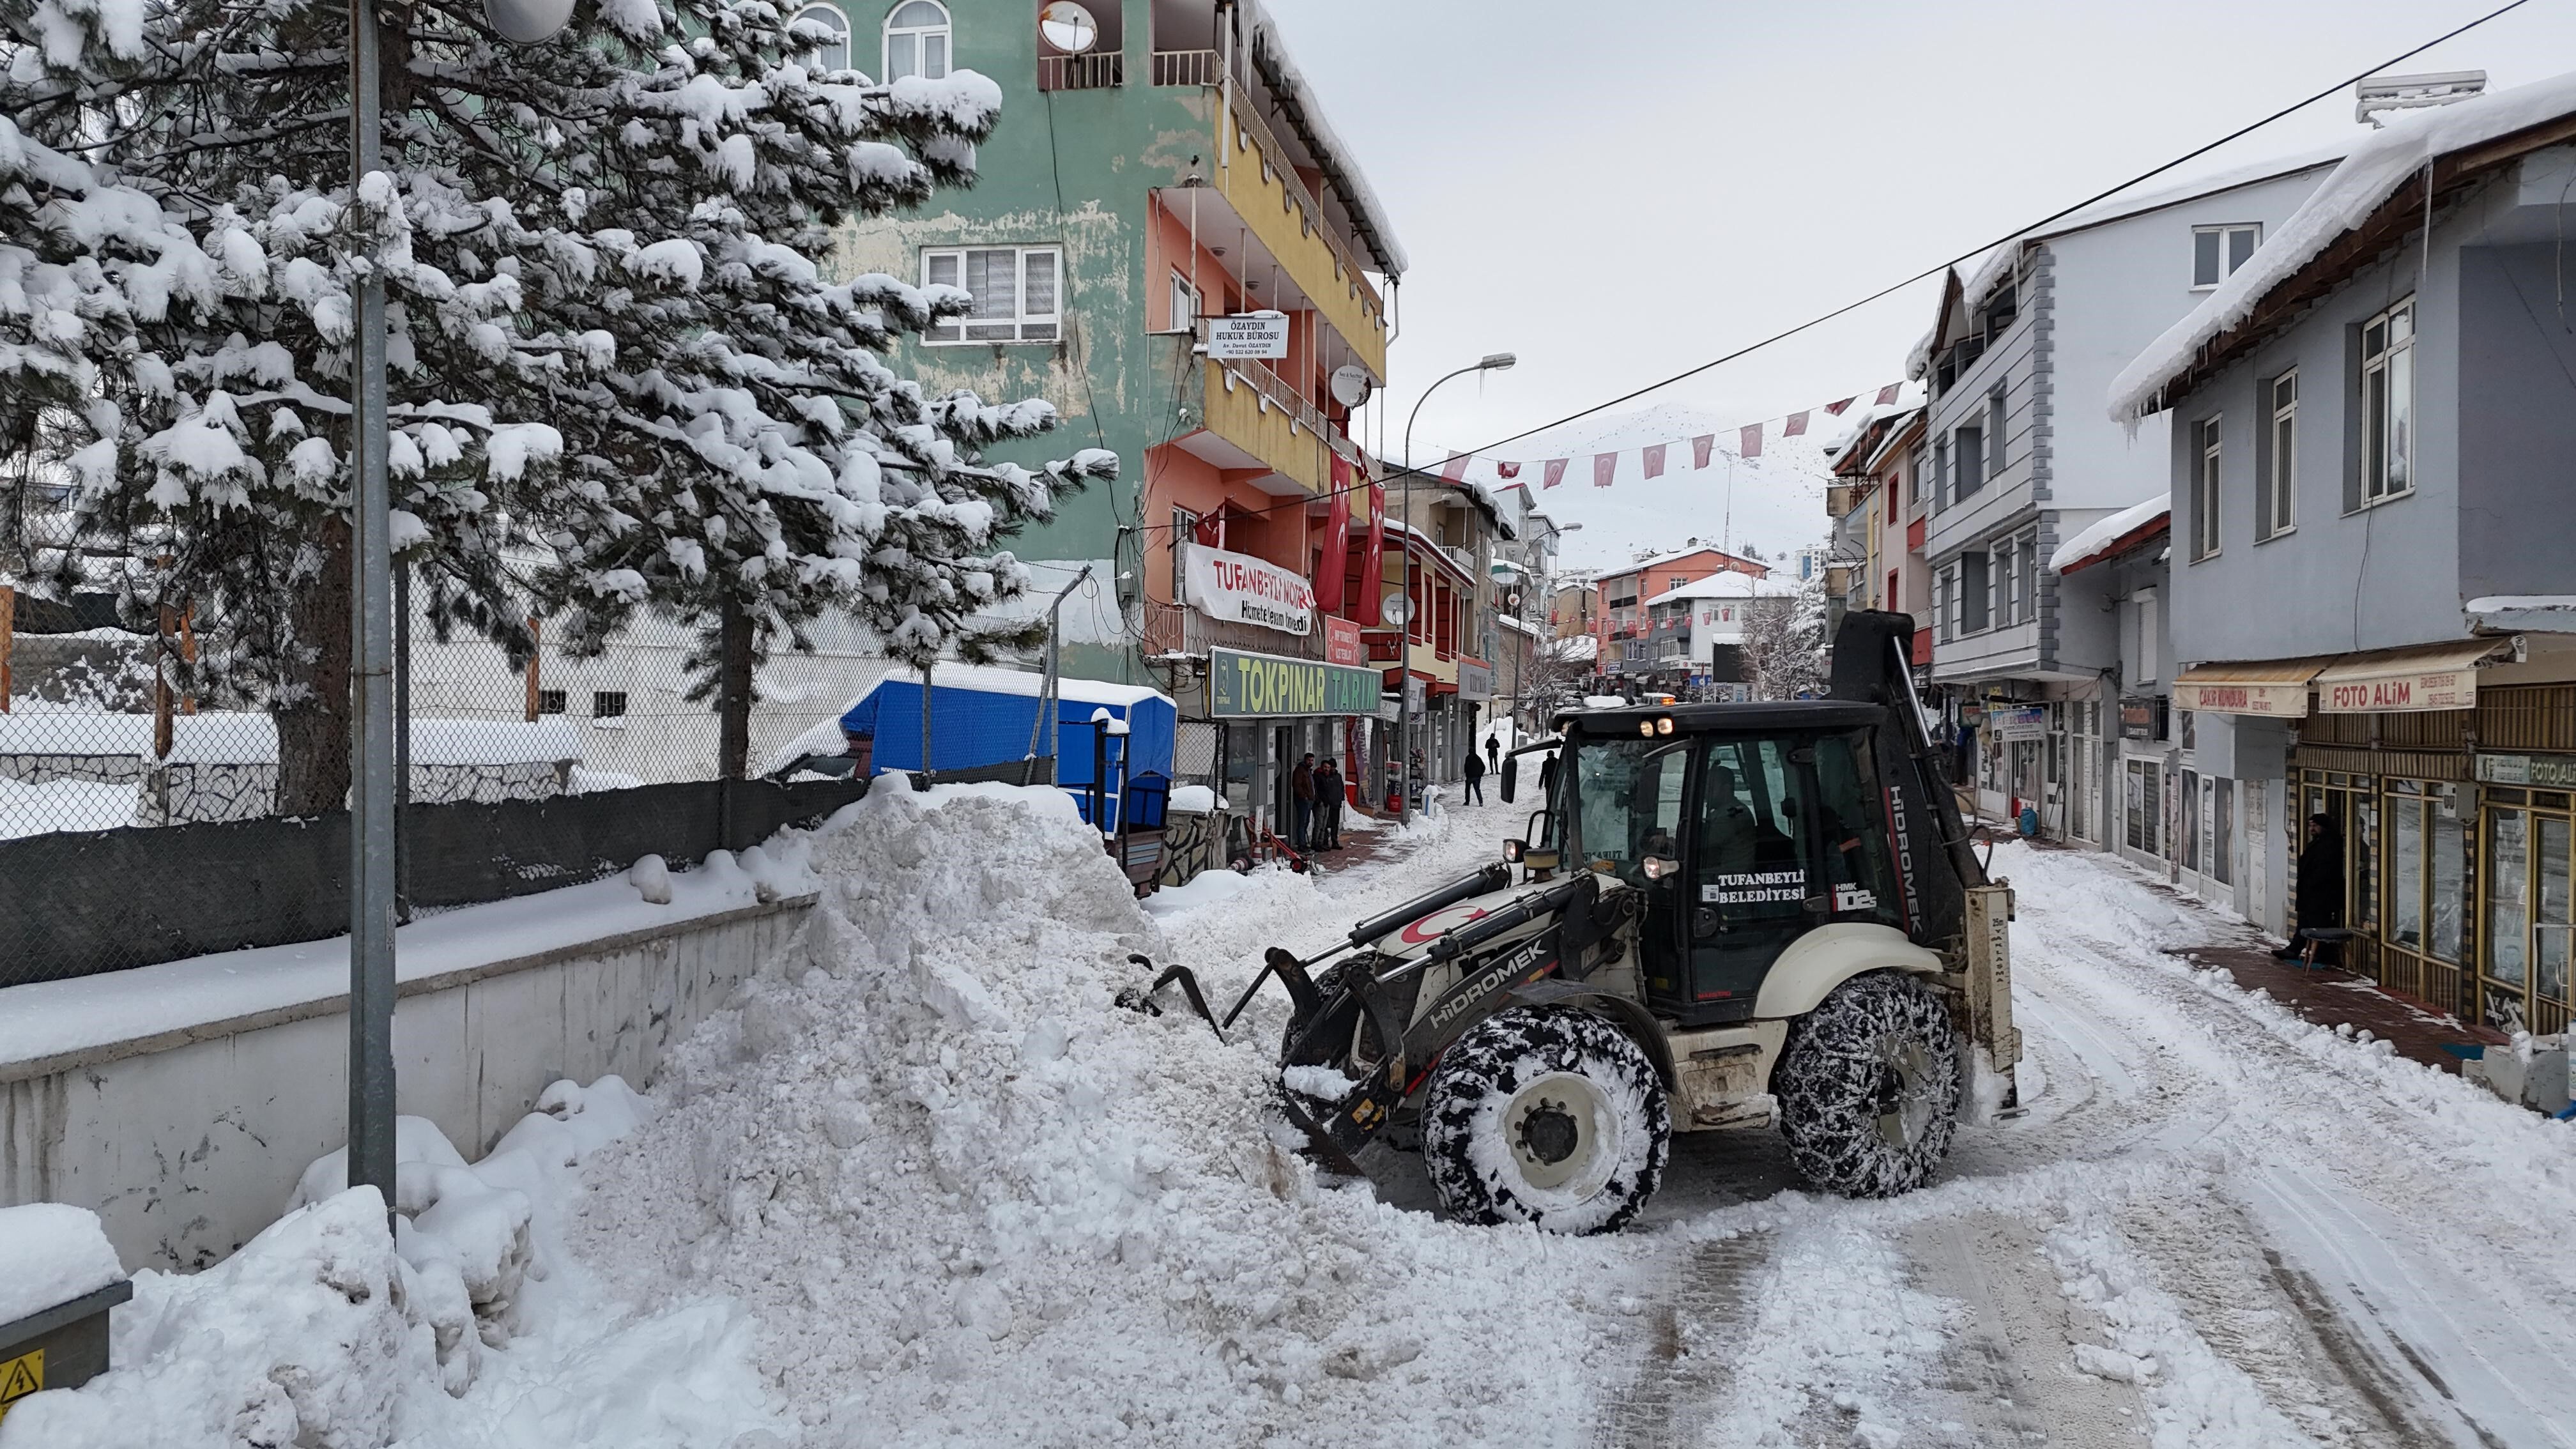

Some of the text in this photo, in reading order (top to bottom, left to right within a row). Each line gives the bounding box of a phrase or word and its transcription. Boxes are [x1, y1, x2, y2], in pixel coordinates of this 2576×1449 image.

[1230, 320, 1266, 330] ÖZAYDIN
[1216, 330, 1280, 340] HUKUK BÜROSU
[1238, 657, 1377, 713] TOKPINAR TARIM
[2218, 687, 2248, 709] KUNDURA
[2333, 684, 2368, 707] FOTO
[2373, 681, 2411, 706] ALİM
[2530, 762, 2557, 781] FOTO
[1718, 869, 1805, 886] TUFANBEYLİ
[1719, 886, 1805, 903] BELEDİYESİ
[1836, 882, 1857, 891] HMK
